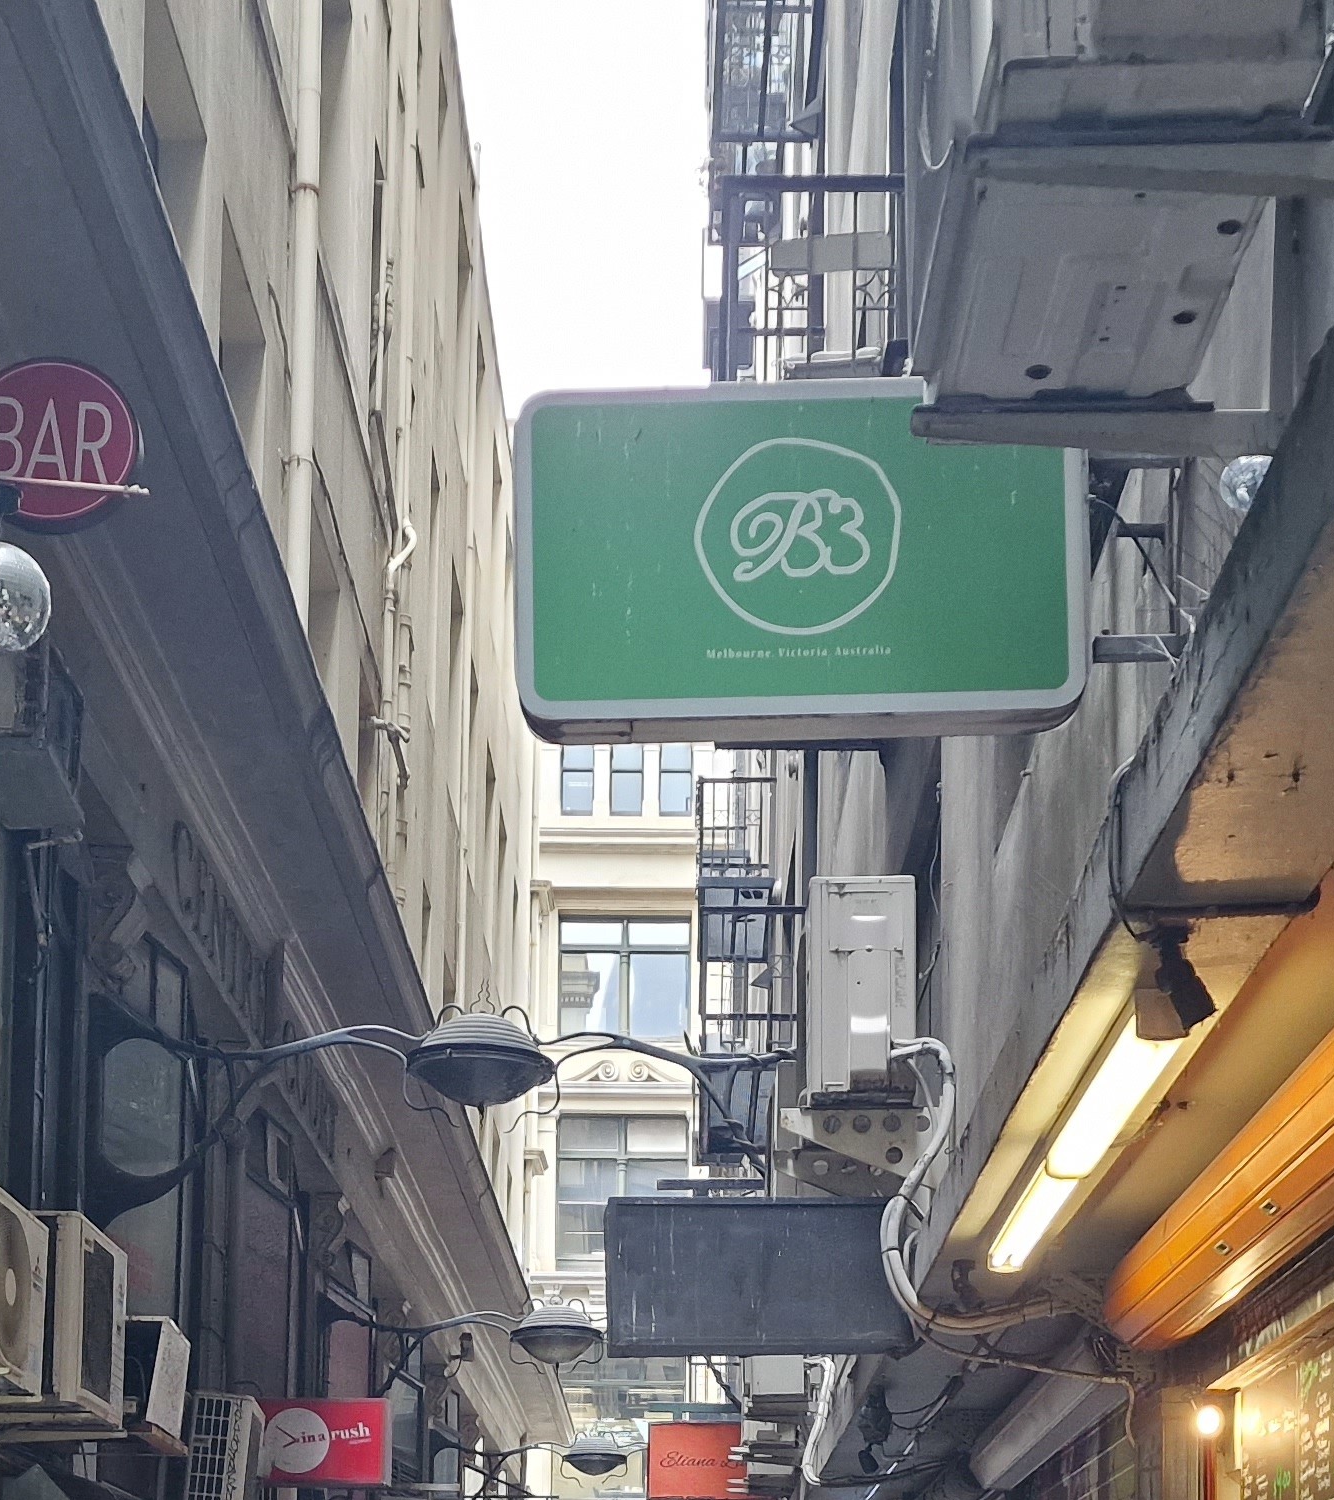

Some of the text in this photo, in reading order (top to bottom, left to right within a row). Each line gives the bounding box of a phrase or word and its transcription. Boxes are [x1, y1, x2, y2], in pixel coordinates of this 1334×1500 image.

[834, 644, 892, 657] Australia
[331, 1421, 371, 1441] rush
[659, 1450, 716, 1468] Eliana
